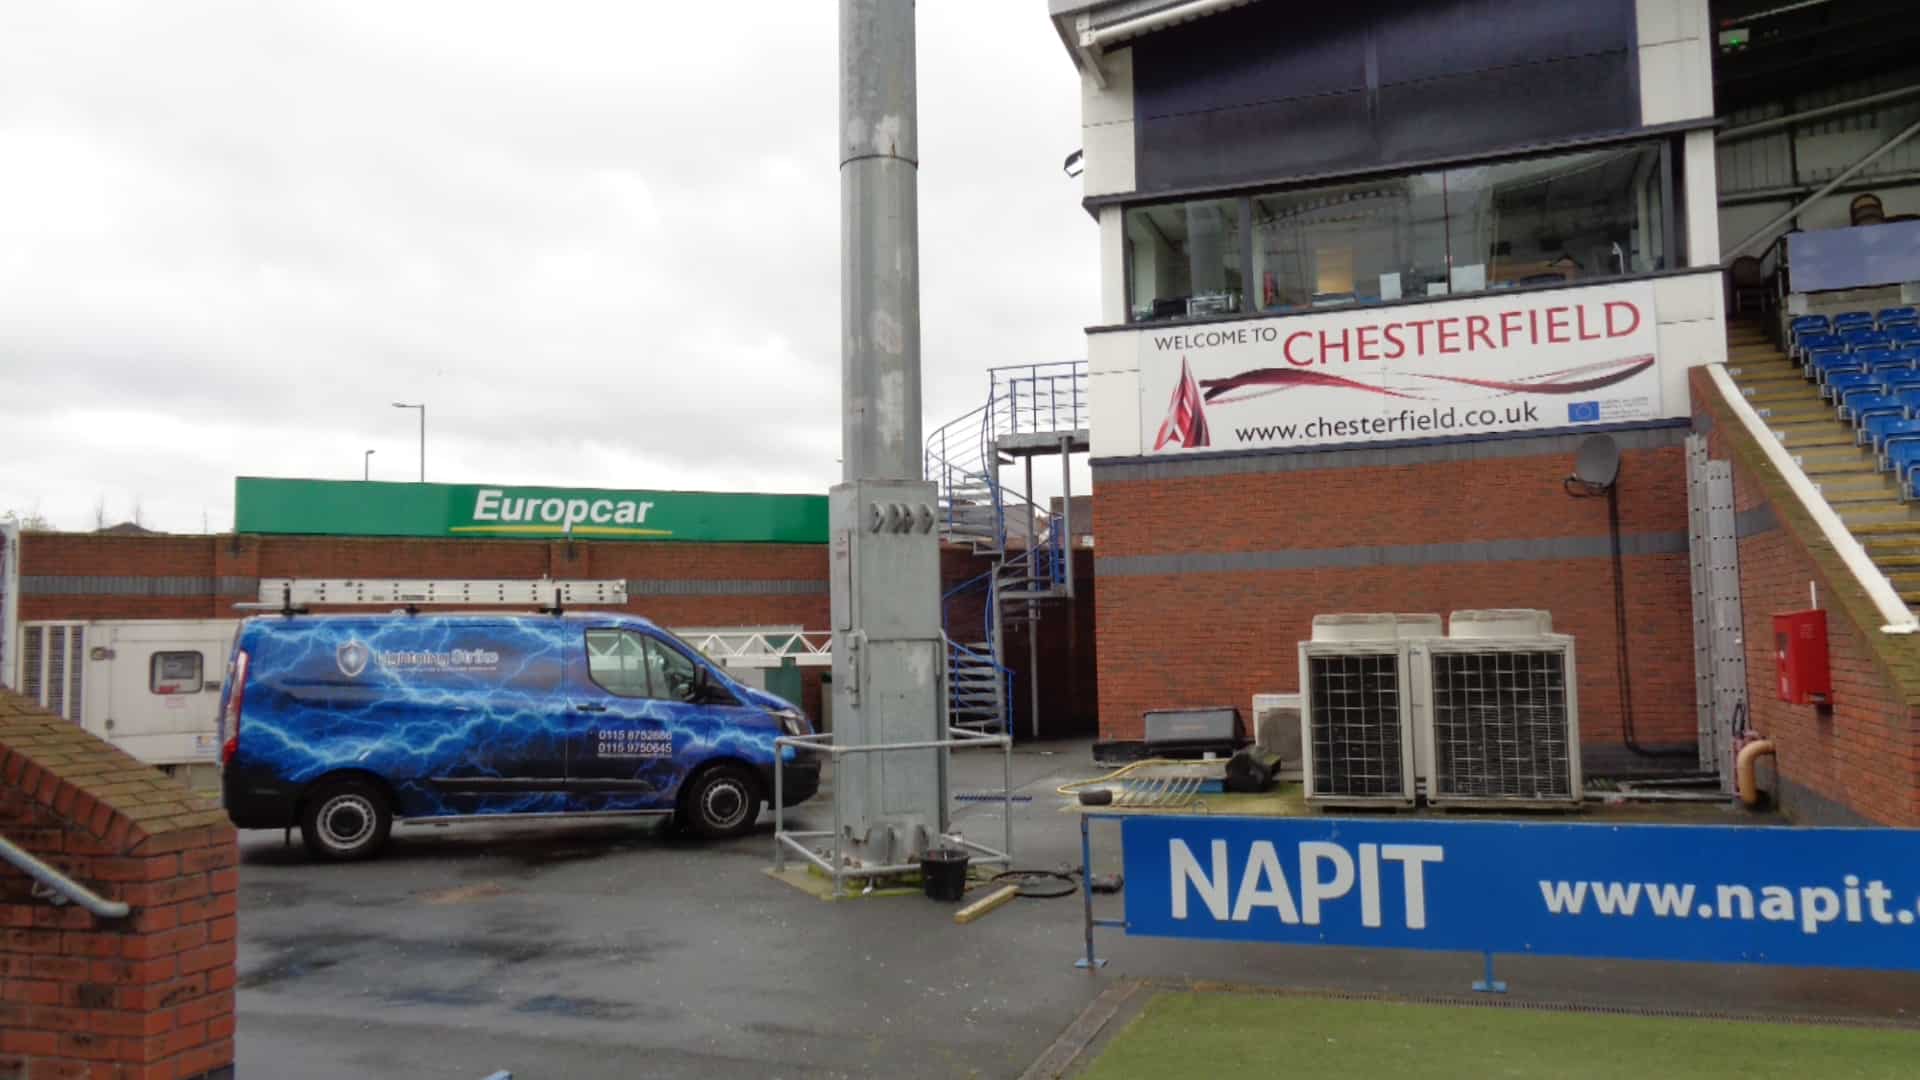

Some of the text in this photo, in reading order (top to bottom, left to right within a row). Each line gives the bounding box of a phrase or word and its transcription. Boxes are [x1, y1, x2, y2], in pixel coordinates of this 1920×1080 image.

[1155, 301, 1641, 367] WELCOME TO CHESTERFIELD
[1235, 401, 1539, 443] www.chesterfield.co.uk
[473, 489, 654, 534] Europcar
[1169, 838, 1444, 930] NAPIT
[1539, 874, 1920, 933] www.napit.
